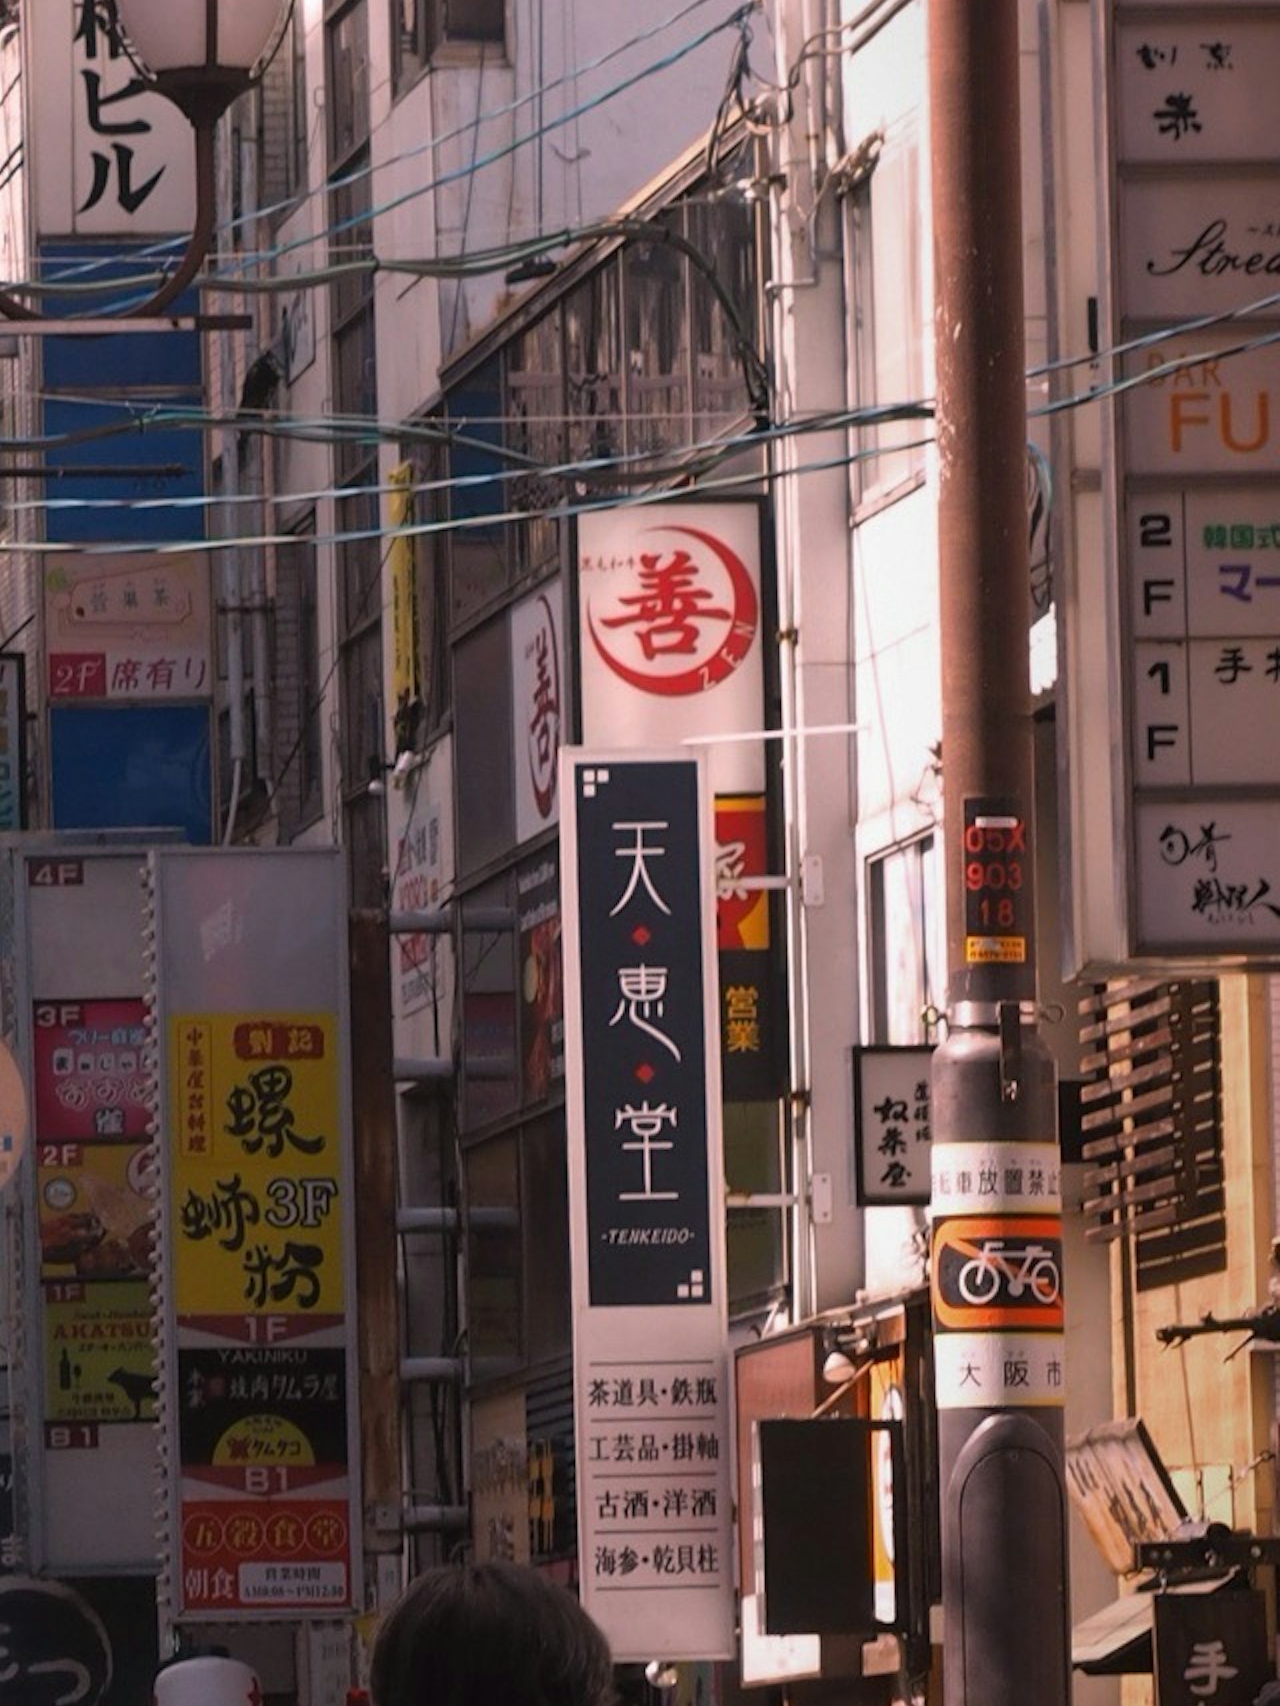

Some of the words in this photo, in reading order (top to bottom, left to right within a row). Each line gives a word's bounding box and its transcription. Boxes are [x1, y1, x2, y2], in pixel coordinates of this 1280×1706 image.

[1147, 351, 1221, 387] BAR
[601, 549, 730, 661] 善
[700, 623, 756, 690] ZEN
[112, 658, 206, 691] 席有り
[34, 863, 78, 884] 4F
[966, 862, 1023, 891] 903
[979, 899, 1014, 927] 18
[37, 1006, 81, 1026] 3F
[608, 820, 684, 1202] 天恵堂
[725, 985, 762, 1055] 営業
[42, 1145, 78, 1165] 2F
[264, 1179, 338, 1228] 3F
[608, 1228, 689, 1245] TENKEIDO
[54, 1285, 82, 1301] 1F
[243, 1316, 288, 1342] 1F
[960, 1359, 1062, 1389] 大阪市
[588, 1376, 718, 1407] 茶道具・鉄瓶
[50, 1427, 92, 1446] B1
[588, 1432, 719, 1462] 工芸品・掛軸
[244, 1467, 288, 1491] B1
[595, 1488, 718, 1519] 古酒・洋酒
[594, 1544, 720, 1575] 海参・乾貝柱
[185, 1568, 236, 1600] 朝食
